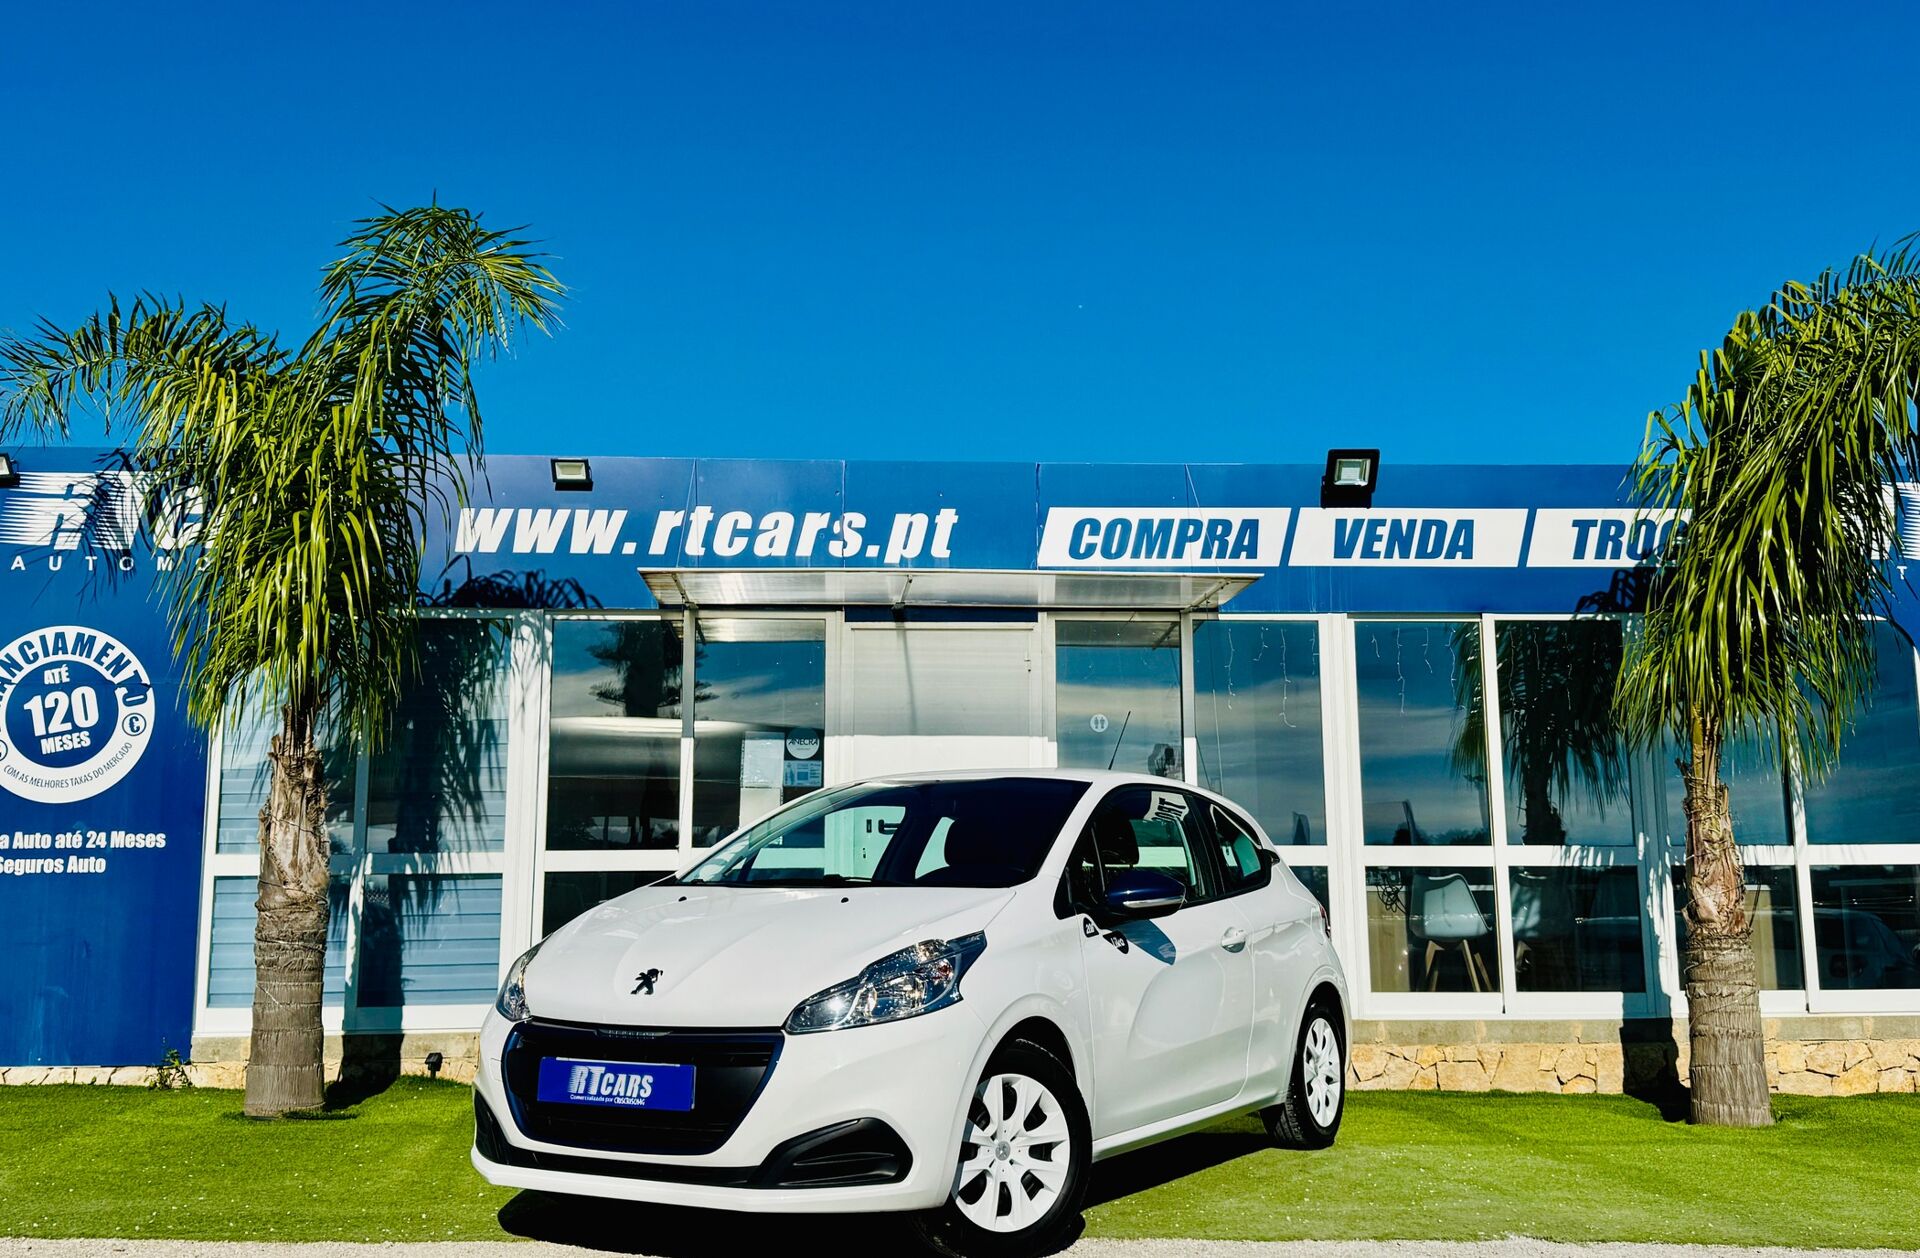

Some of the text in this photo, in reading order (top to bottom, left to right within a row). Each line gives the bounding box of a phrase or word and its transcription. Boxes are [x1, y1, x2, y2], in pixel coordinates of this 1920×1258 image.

[454, 506, 959, 564] www.rtcars.pt
[1067, 517, 1260, 560] COMPRA
[1333, 518, 1474, 560] VENDA
[43, 664, 71, 685] ATÉ
[24, 686, 99, 737] 120
[40, 730, 91, 755] MESES
[3, 742, 133, 789] COM AS MELHORES TAXAS DO MERCADO
[12, 831, 52, 849] Auto
[54, 830, 83, 849] até
[86, 831, 107, 849] 24
[110, 831, 167, 849] Meses
[66, 855, 107, 874] Auto
